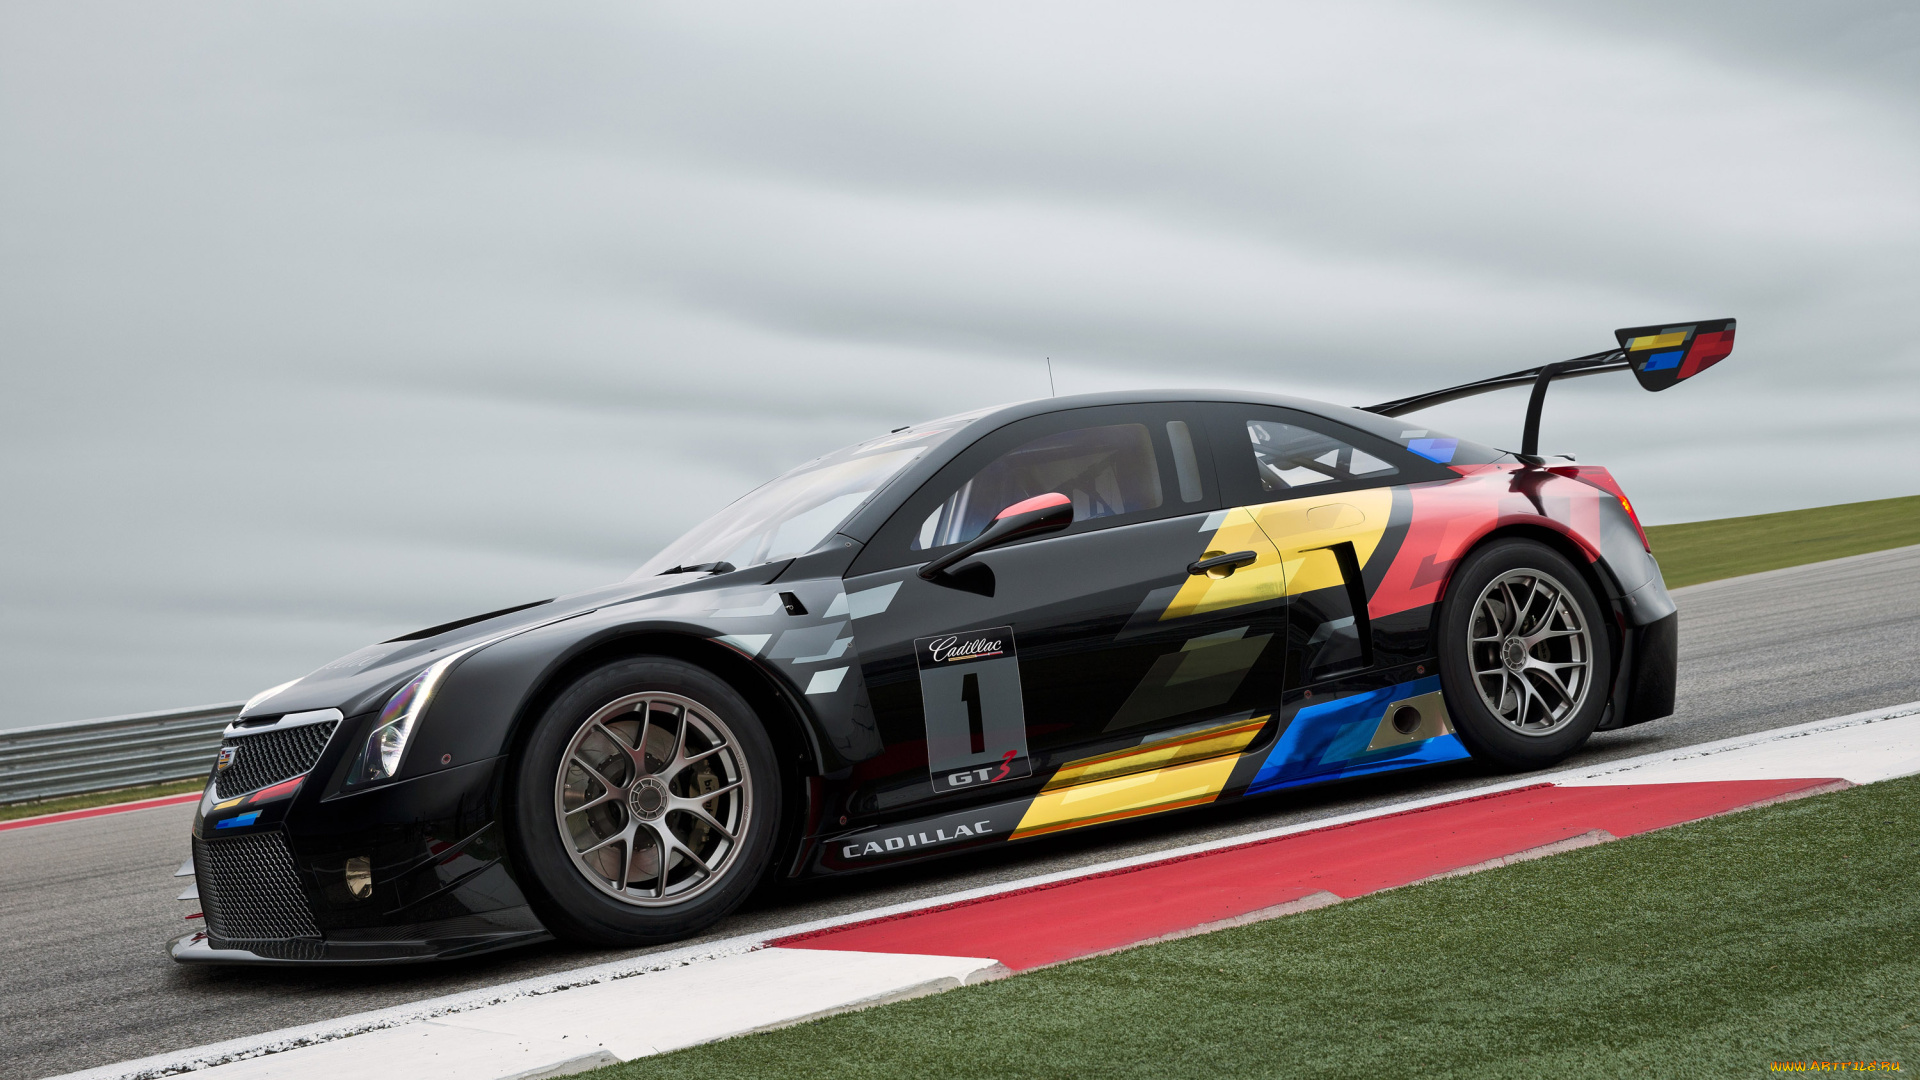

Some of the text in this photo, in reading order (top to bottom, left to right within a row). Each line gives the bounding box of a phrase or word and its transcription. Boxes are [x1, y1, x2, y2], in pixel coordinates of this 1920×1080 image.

[929, 636, 1002, 662] Cadillac
[961, 672, 985, 754] 1
[948, 749, 1018, 786] GT3
[704, 779, 713, 814] brmb
[842, 820, 993, 859] CADILLAC
